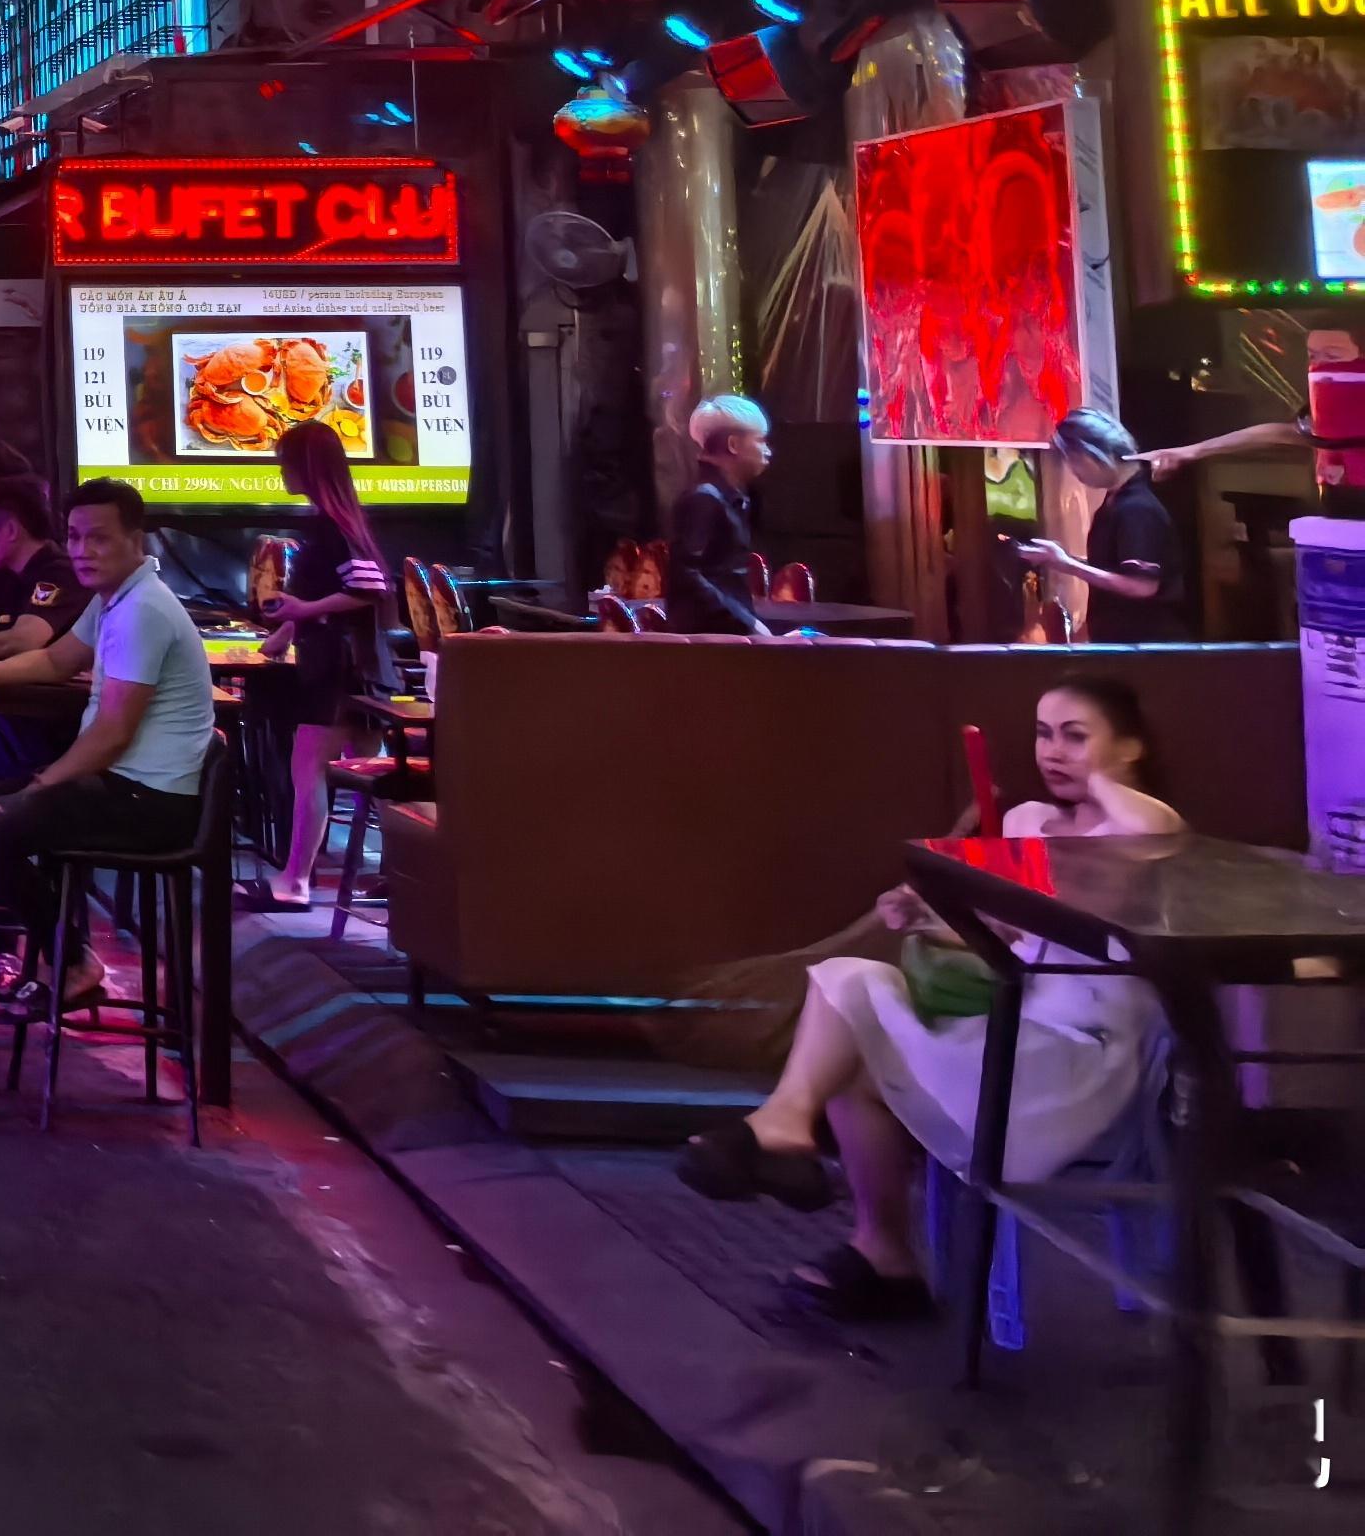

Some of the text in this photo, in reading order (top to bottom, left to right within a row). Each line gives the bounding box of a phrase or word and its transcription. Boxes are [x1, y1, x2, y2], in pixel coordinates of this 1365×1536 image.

[83, 347, 105, 361] 119
[420, 347, 443, 361] 119
[84, 370, 106, 384] 121
[84, 390, 112, 408] BÙI
[422, 390, 452, 408] BÙI
[85, 416, 125, 435] VIỆN
[422, 416, 465, 436] VIỆN
[352, 478, 374, 492] NLY
